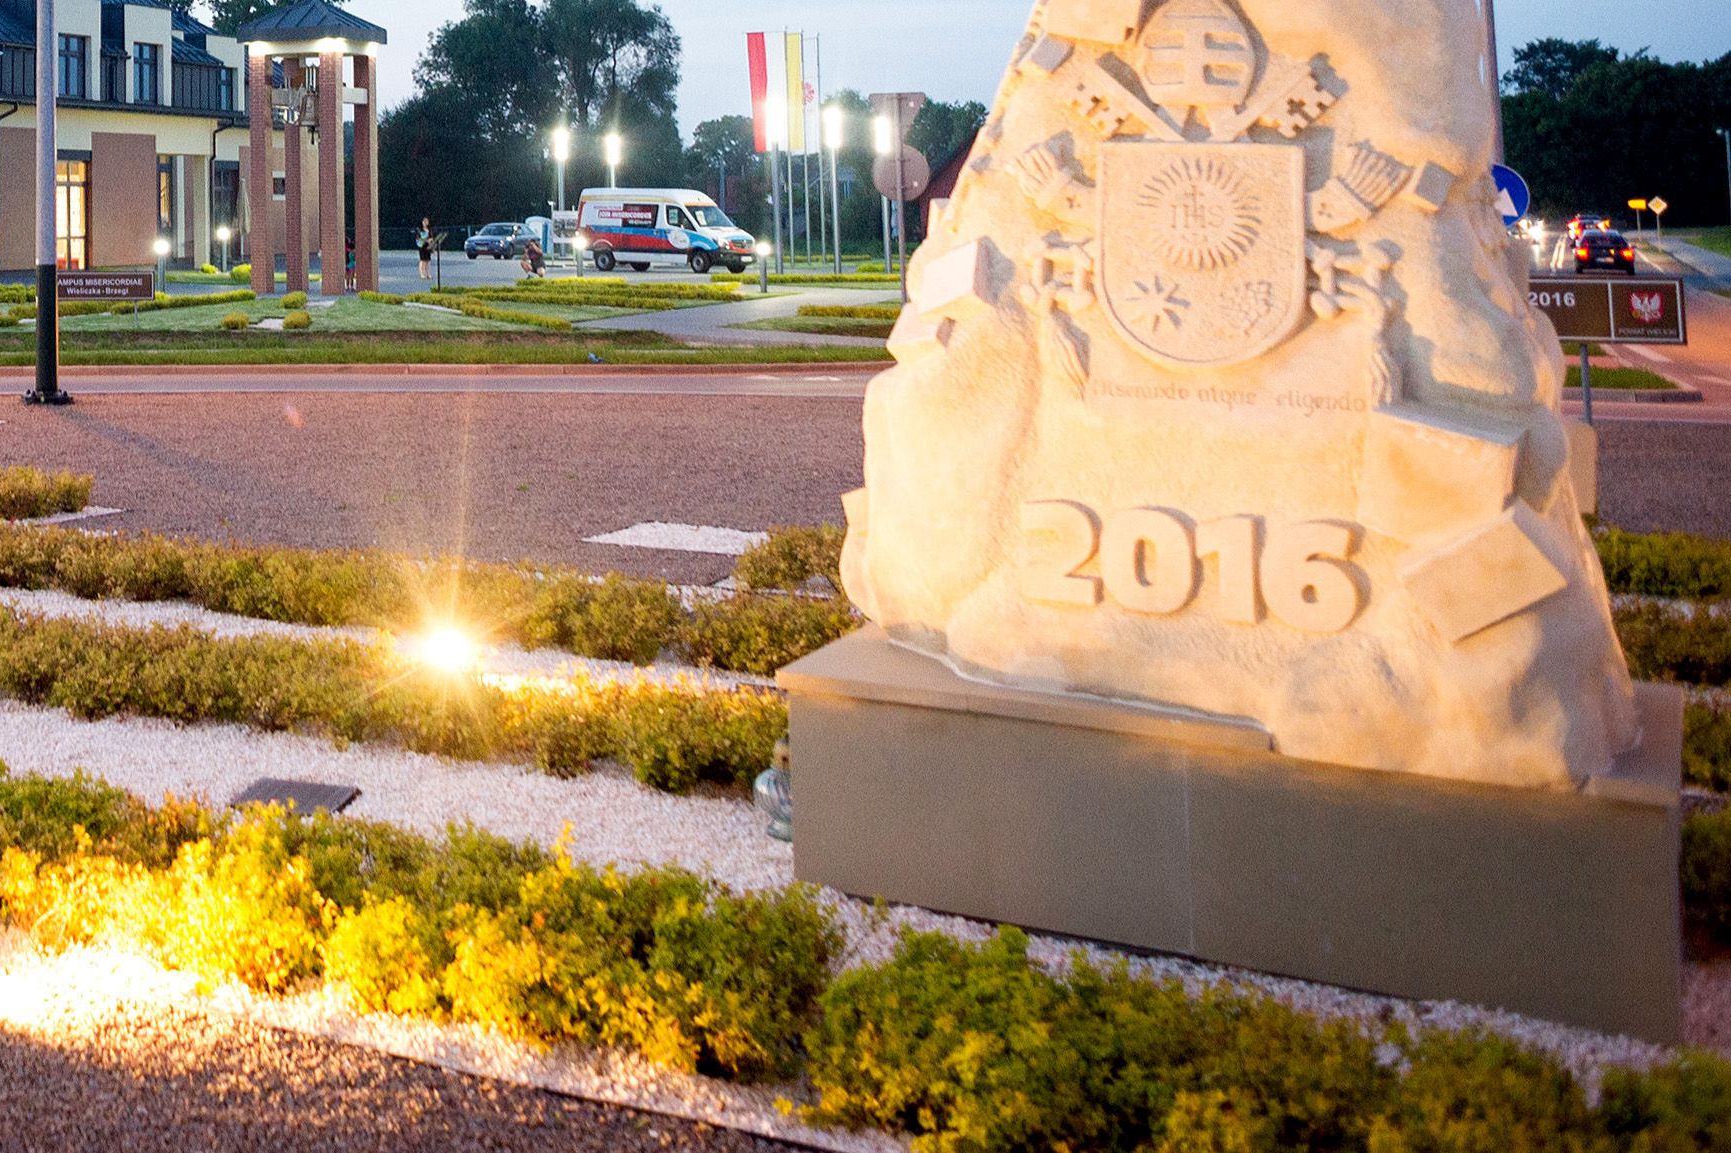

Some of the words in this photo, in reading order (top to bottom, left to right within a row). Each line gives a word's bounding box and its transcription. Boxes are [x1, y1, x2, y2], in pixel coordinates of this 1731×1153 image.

[58, 278, 83, 286] AMPUS
[85, 278, 142, 286] MISERICORDIAE
[1529, 291, 1576, 307] 2016
[1018, 498, 1372, 635] 2016
